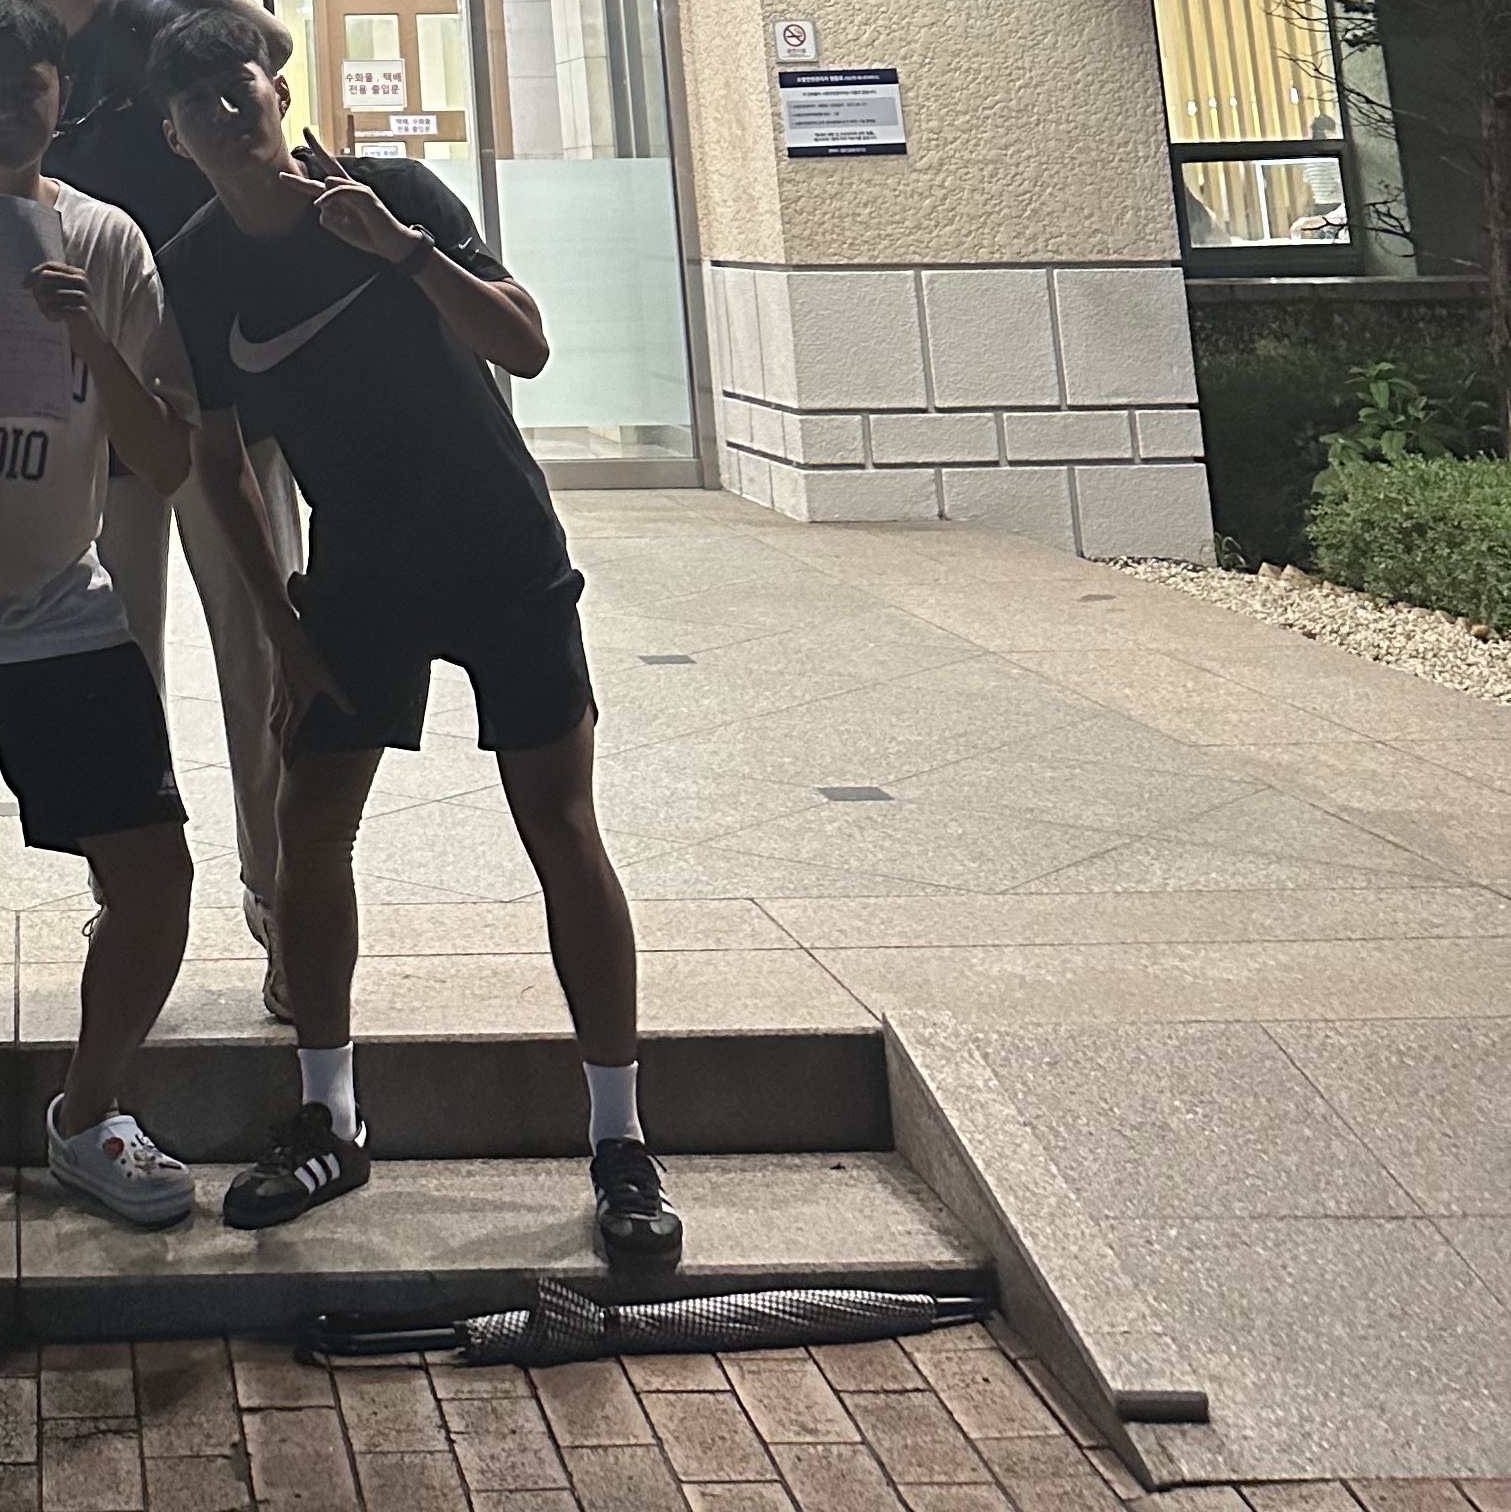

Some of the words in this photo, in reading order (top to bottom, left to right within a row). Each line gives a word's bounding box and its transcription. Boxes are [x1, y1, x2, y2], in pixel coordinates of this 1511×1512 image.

[345, 72, 373, 83] 수화물
[383, 72, 402, 83] 택배
[371, 84, 400, 95] 출입문
